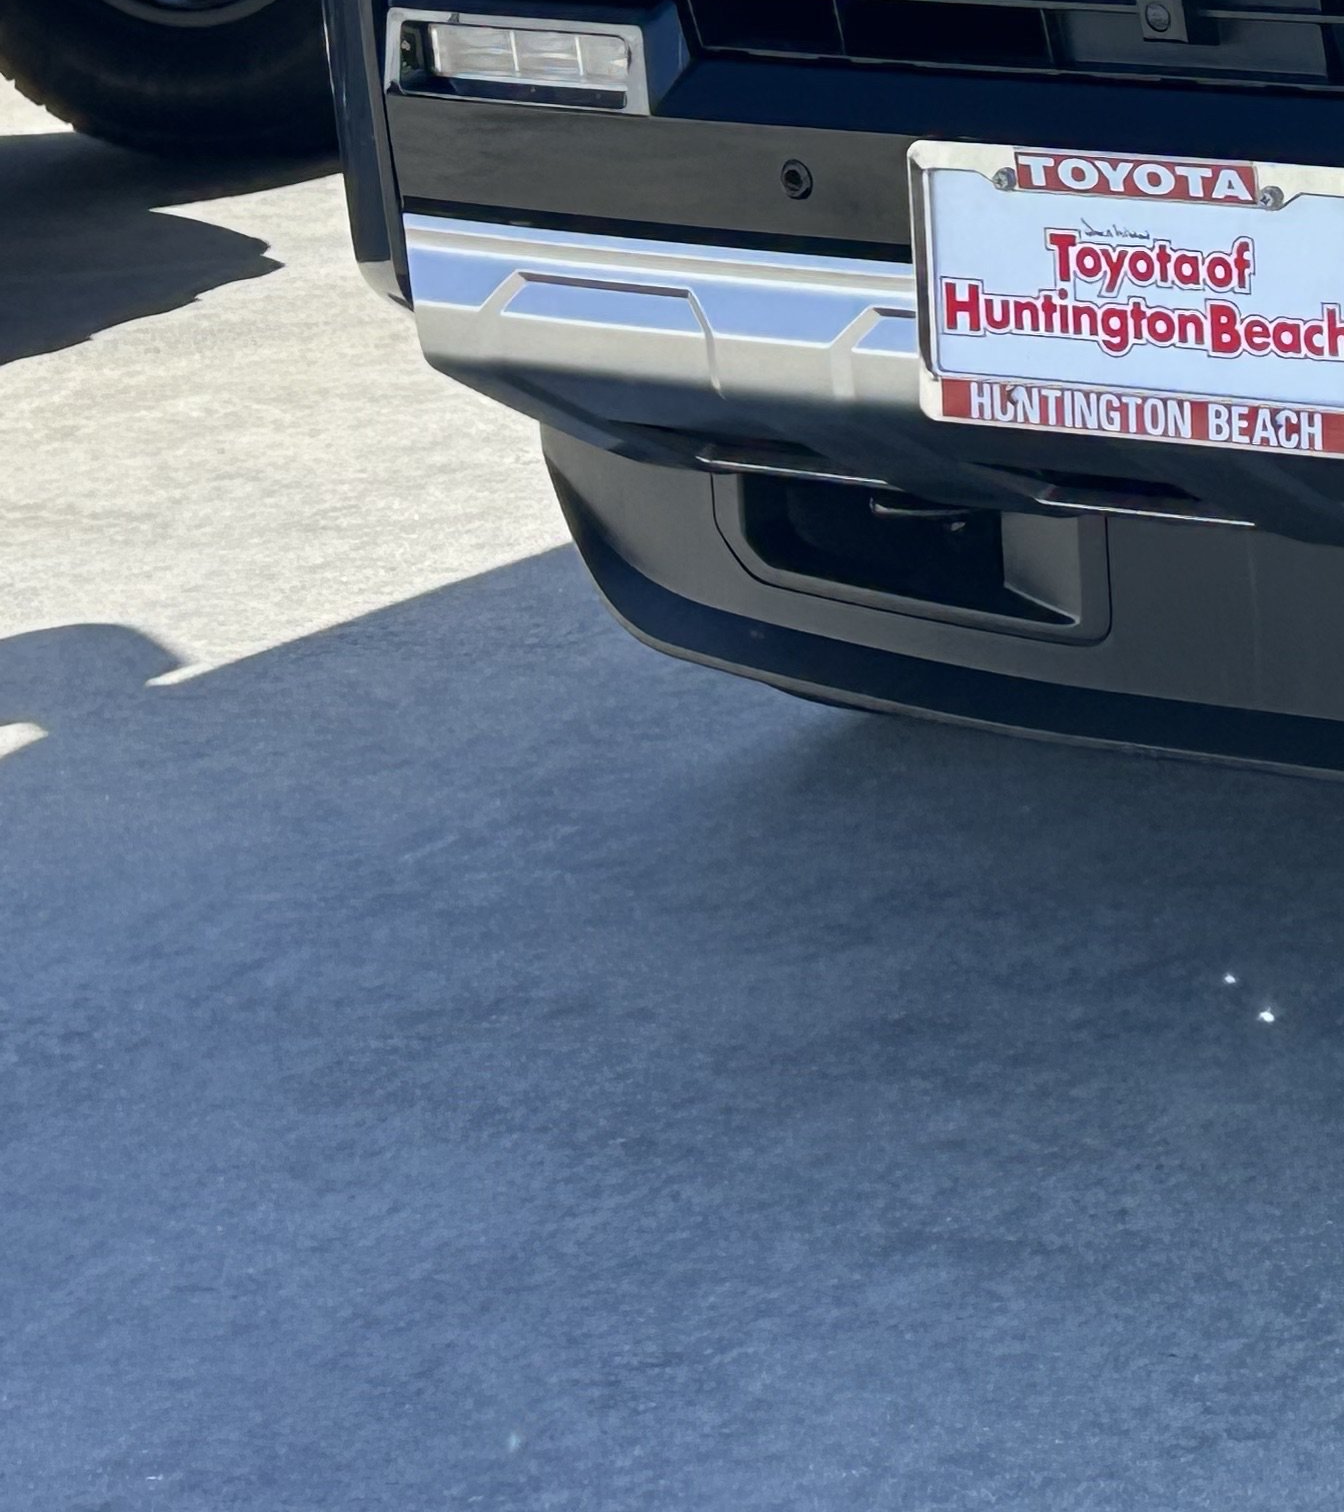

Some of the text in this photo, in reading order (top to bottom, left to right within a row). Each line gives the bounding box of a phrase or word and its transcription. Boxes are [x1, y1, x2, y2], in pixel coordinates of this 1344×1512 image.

[1018, 157, 1253, 201] TOYOTA
[1049, 233, 1251, 292] Toyota of
[944, 282, 1204, 352] Huntington
[970, 383, 1323, 451] HUNTINGTON BEACH
